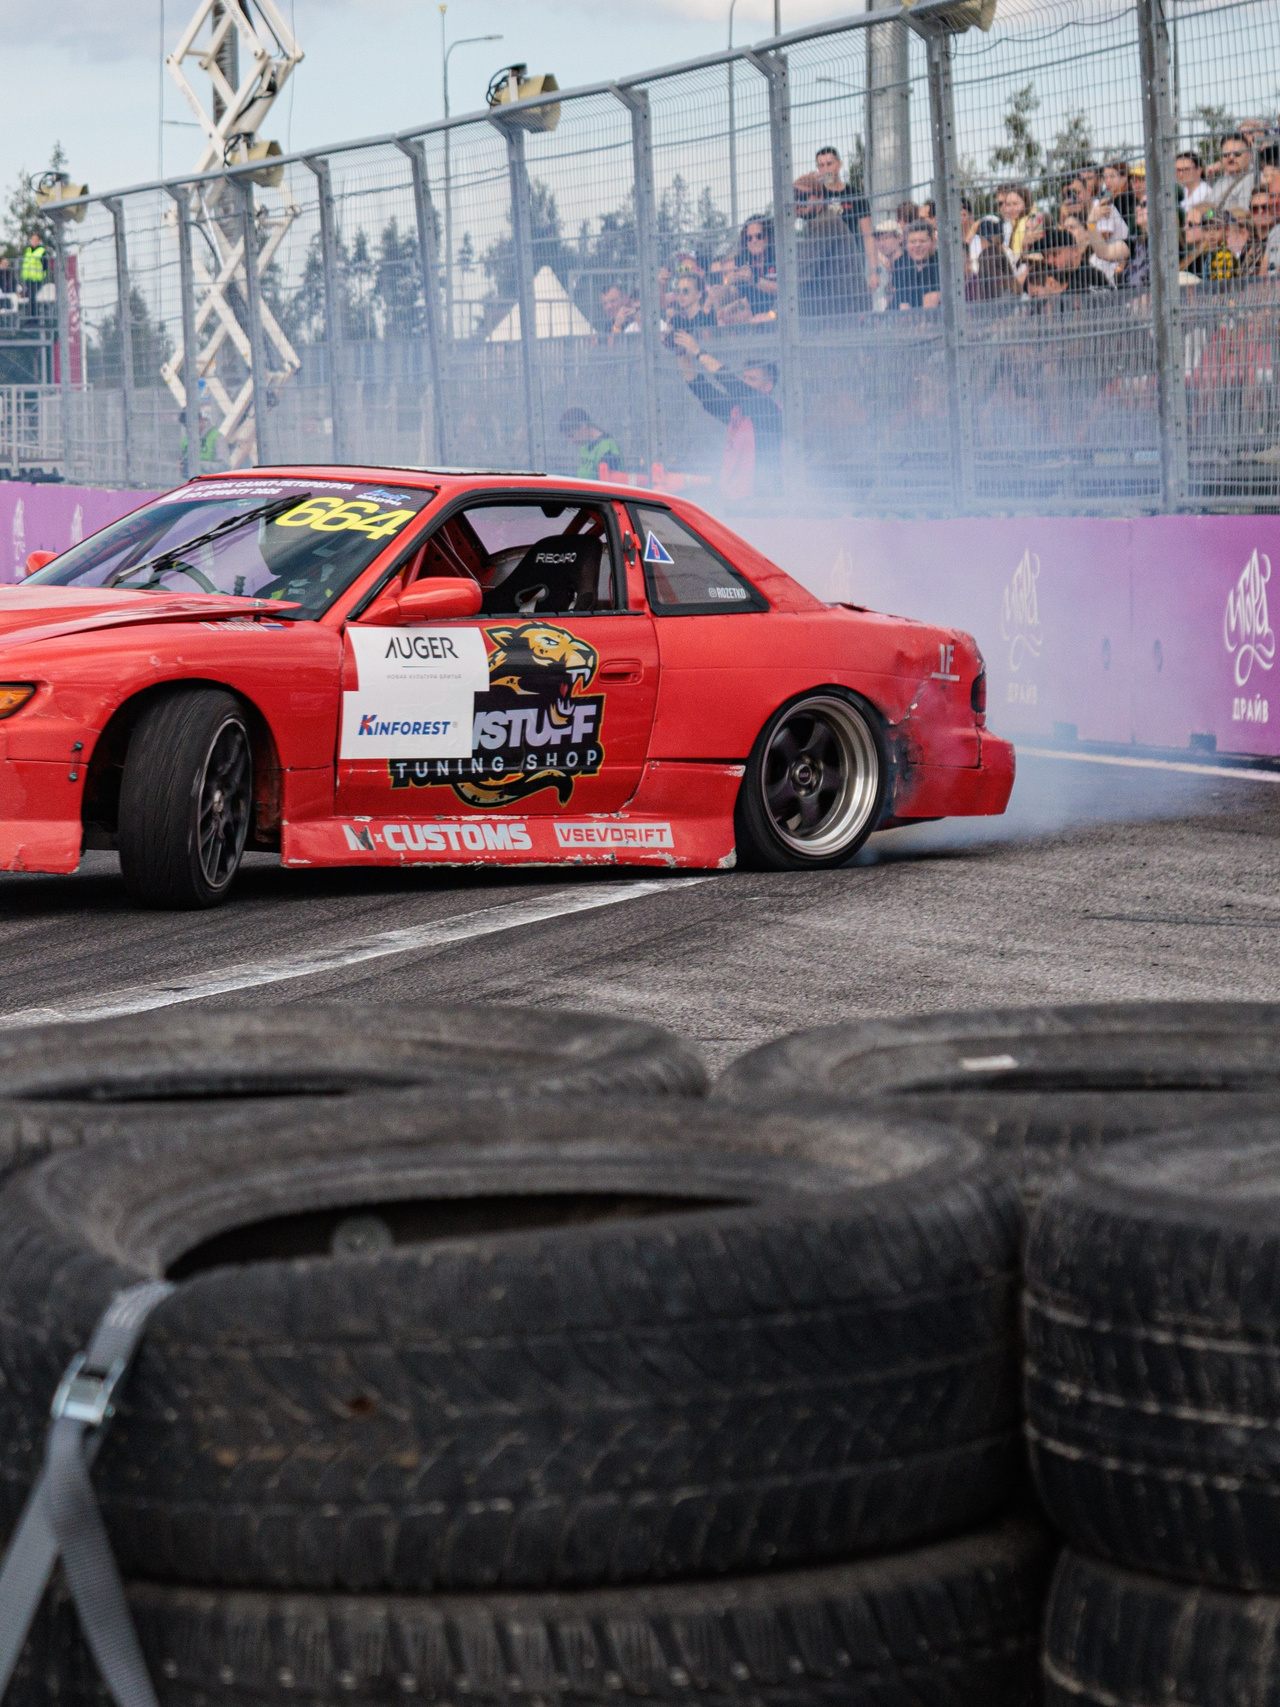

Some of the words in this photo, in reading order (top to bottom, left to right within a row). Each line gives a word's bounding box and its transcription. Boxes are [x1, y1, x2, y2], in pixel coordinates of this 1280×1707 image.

[275, 497, 417, 540] 664
[535, 552, 577, 564] RECARO
[385, 636, 459, 659] AUGER
[1232, 693, 1269, 723] ДРАЙВ
[358, 714, 451, 736] KINFOREST
[396, 756, 504, 778] TUNING
[526, 750, 597, 770] SHOP
[559, 828, 667, 843] VSEVDRIFT
